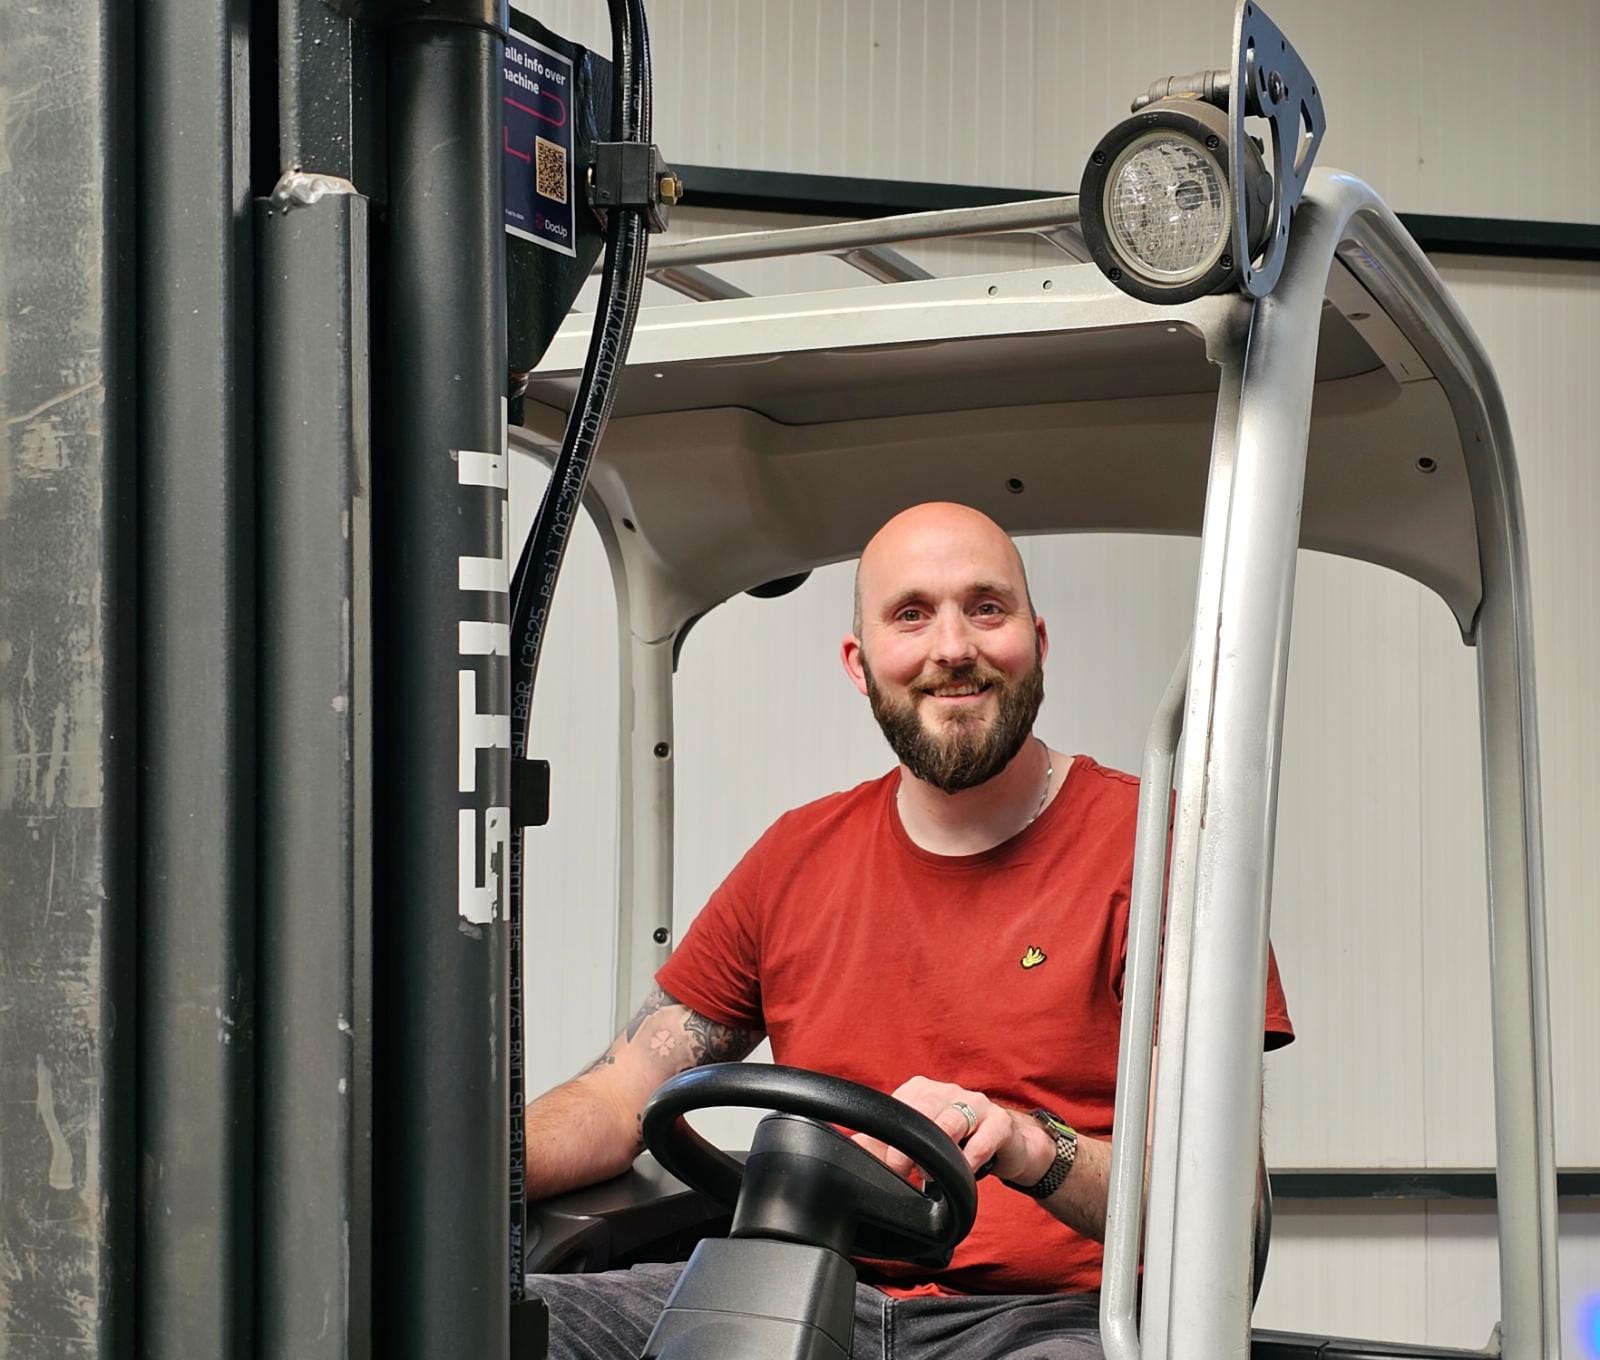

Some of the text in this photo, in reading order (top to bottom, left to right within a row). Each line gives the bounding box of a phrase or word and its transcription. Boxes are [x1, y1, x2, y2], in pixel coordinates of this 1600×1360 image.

[505, 46, 566, 86] alle info over
[545, 219, 568, 238] DocUp
[540, 549, 561, 598] psi)
[521, 606, 547, 668] (3625
[458, 396, 511, 925] STILL
[512, 681, 533, 720] BAR
[511, 731, 525, 758] 50
